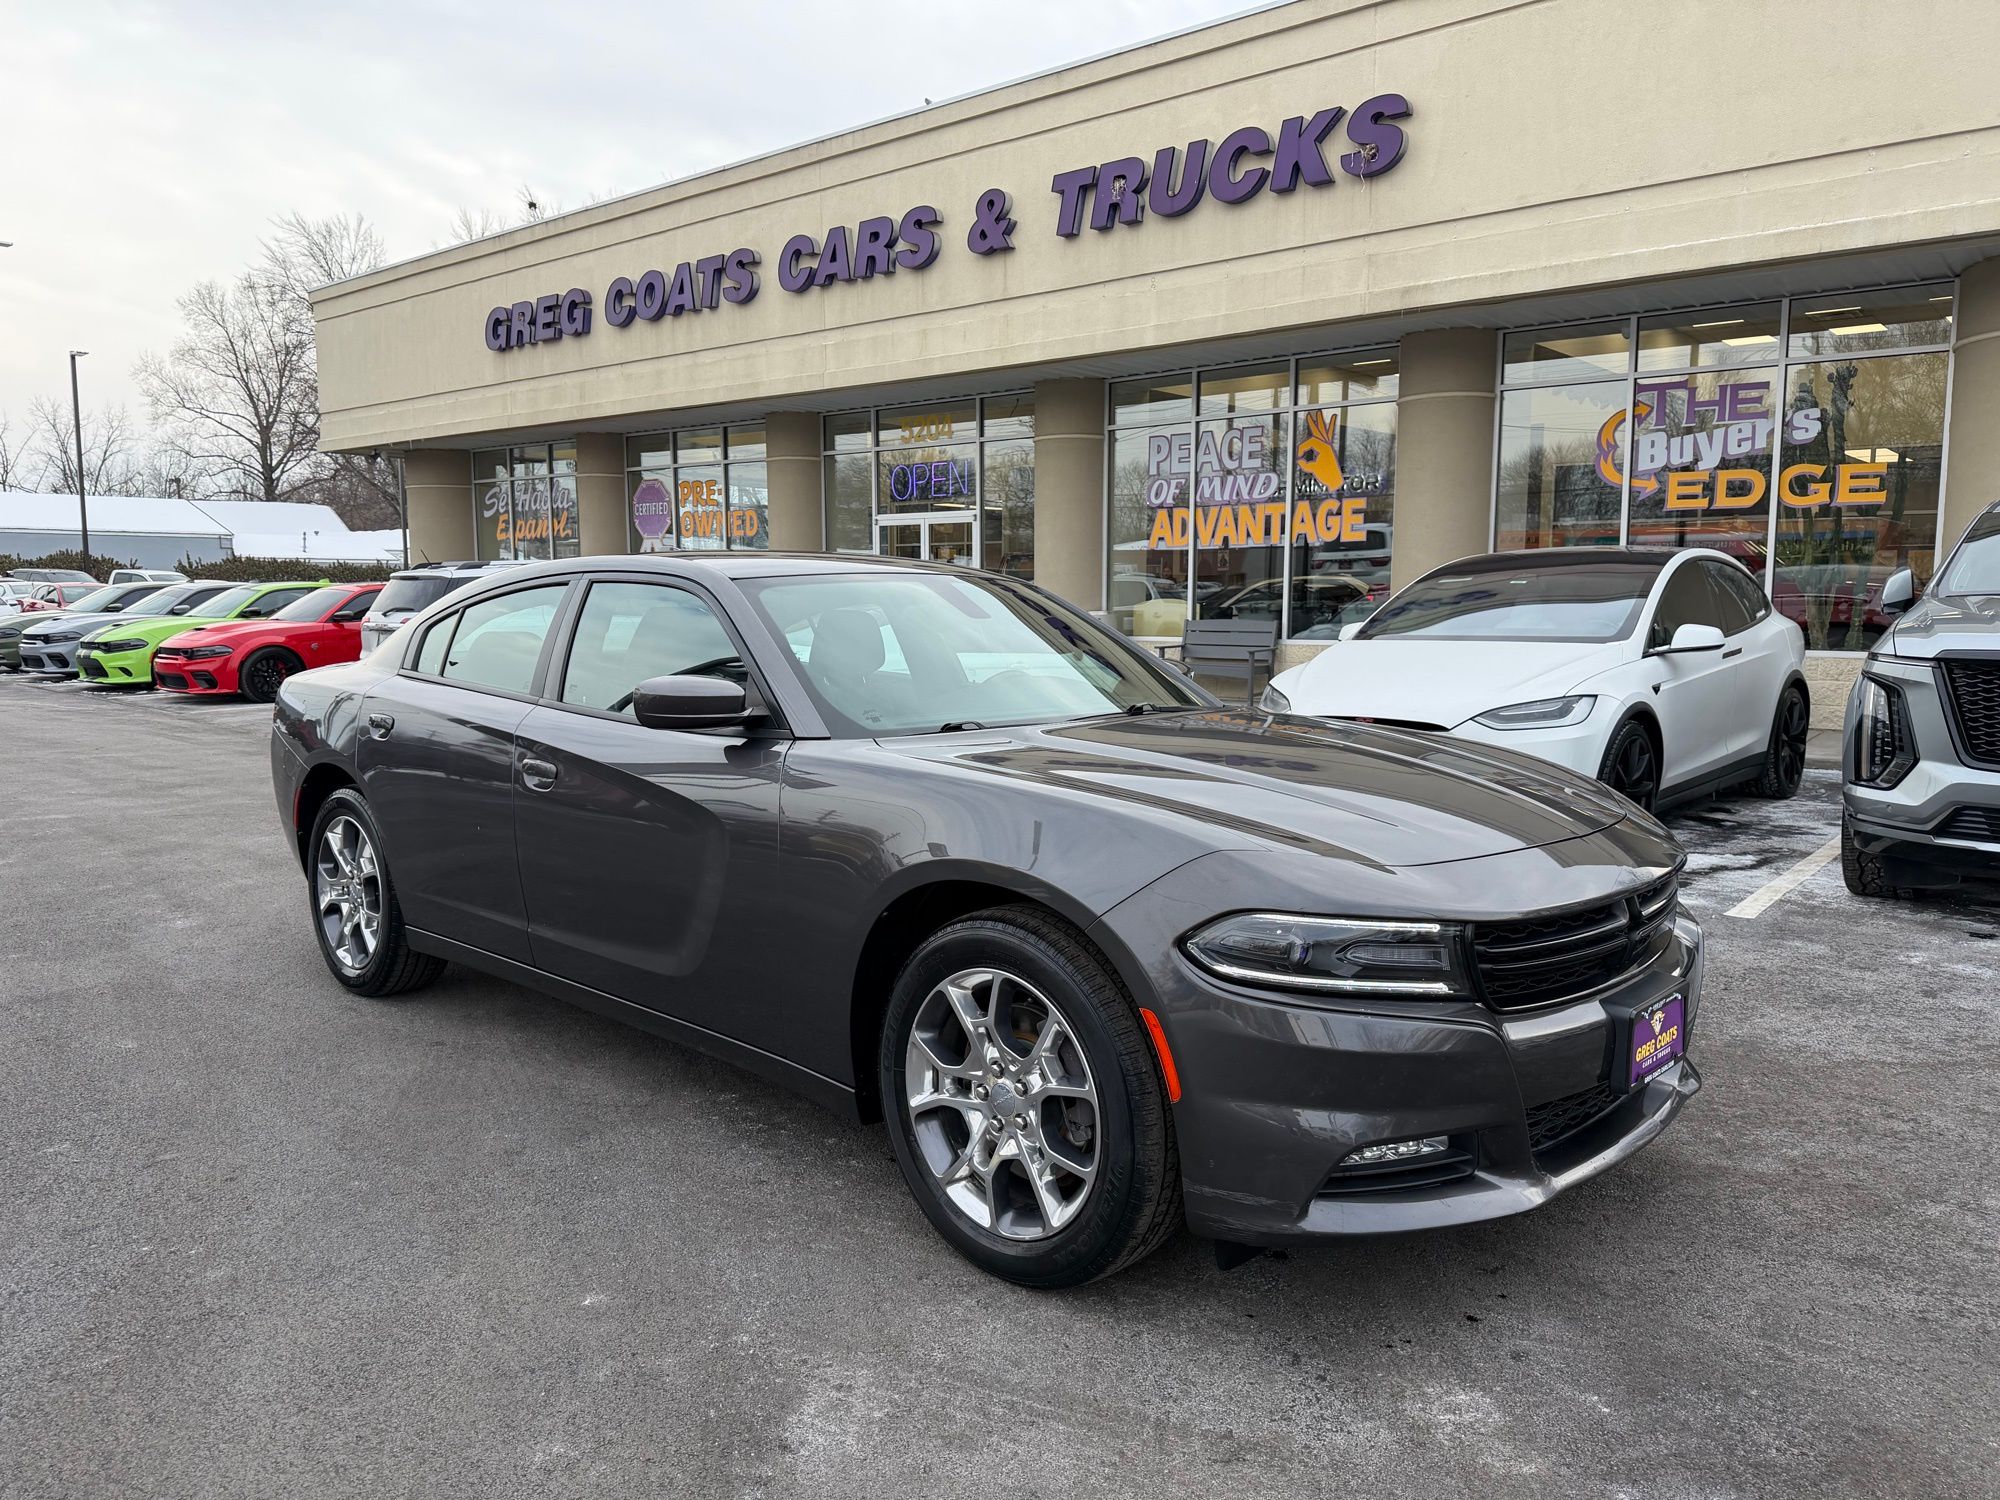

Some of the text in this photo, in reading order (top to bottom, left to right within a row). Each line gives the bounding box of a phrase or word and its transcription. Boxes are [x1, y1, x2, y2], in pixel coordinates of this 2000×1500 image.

[485, 93, 1413, 352] GREG COATS CARS & TRUCKS
[1636, 377, 1771, 430] THE
[901, 415, 954, 444] 5204
[1149, 425, 1265, 476] PEACE
[891, 458, 968, 500] OPEN
[1148, 479, 1188, 508] OF
[1195, 472, 1279, 506] MIND
[1663, 461, 1888, 511] EDGE
[483, 486, 507, 518] Se
[634, 502, 669, 516] CERTIFIED
[680, 509, 759, 538] OWNED
[1148, 497, 1368, 549] ADVANTAGE
[1635, 1025, 1678, 1062] GREG COATS
